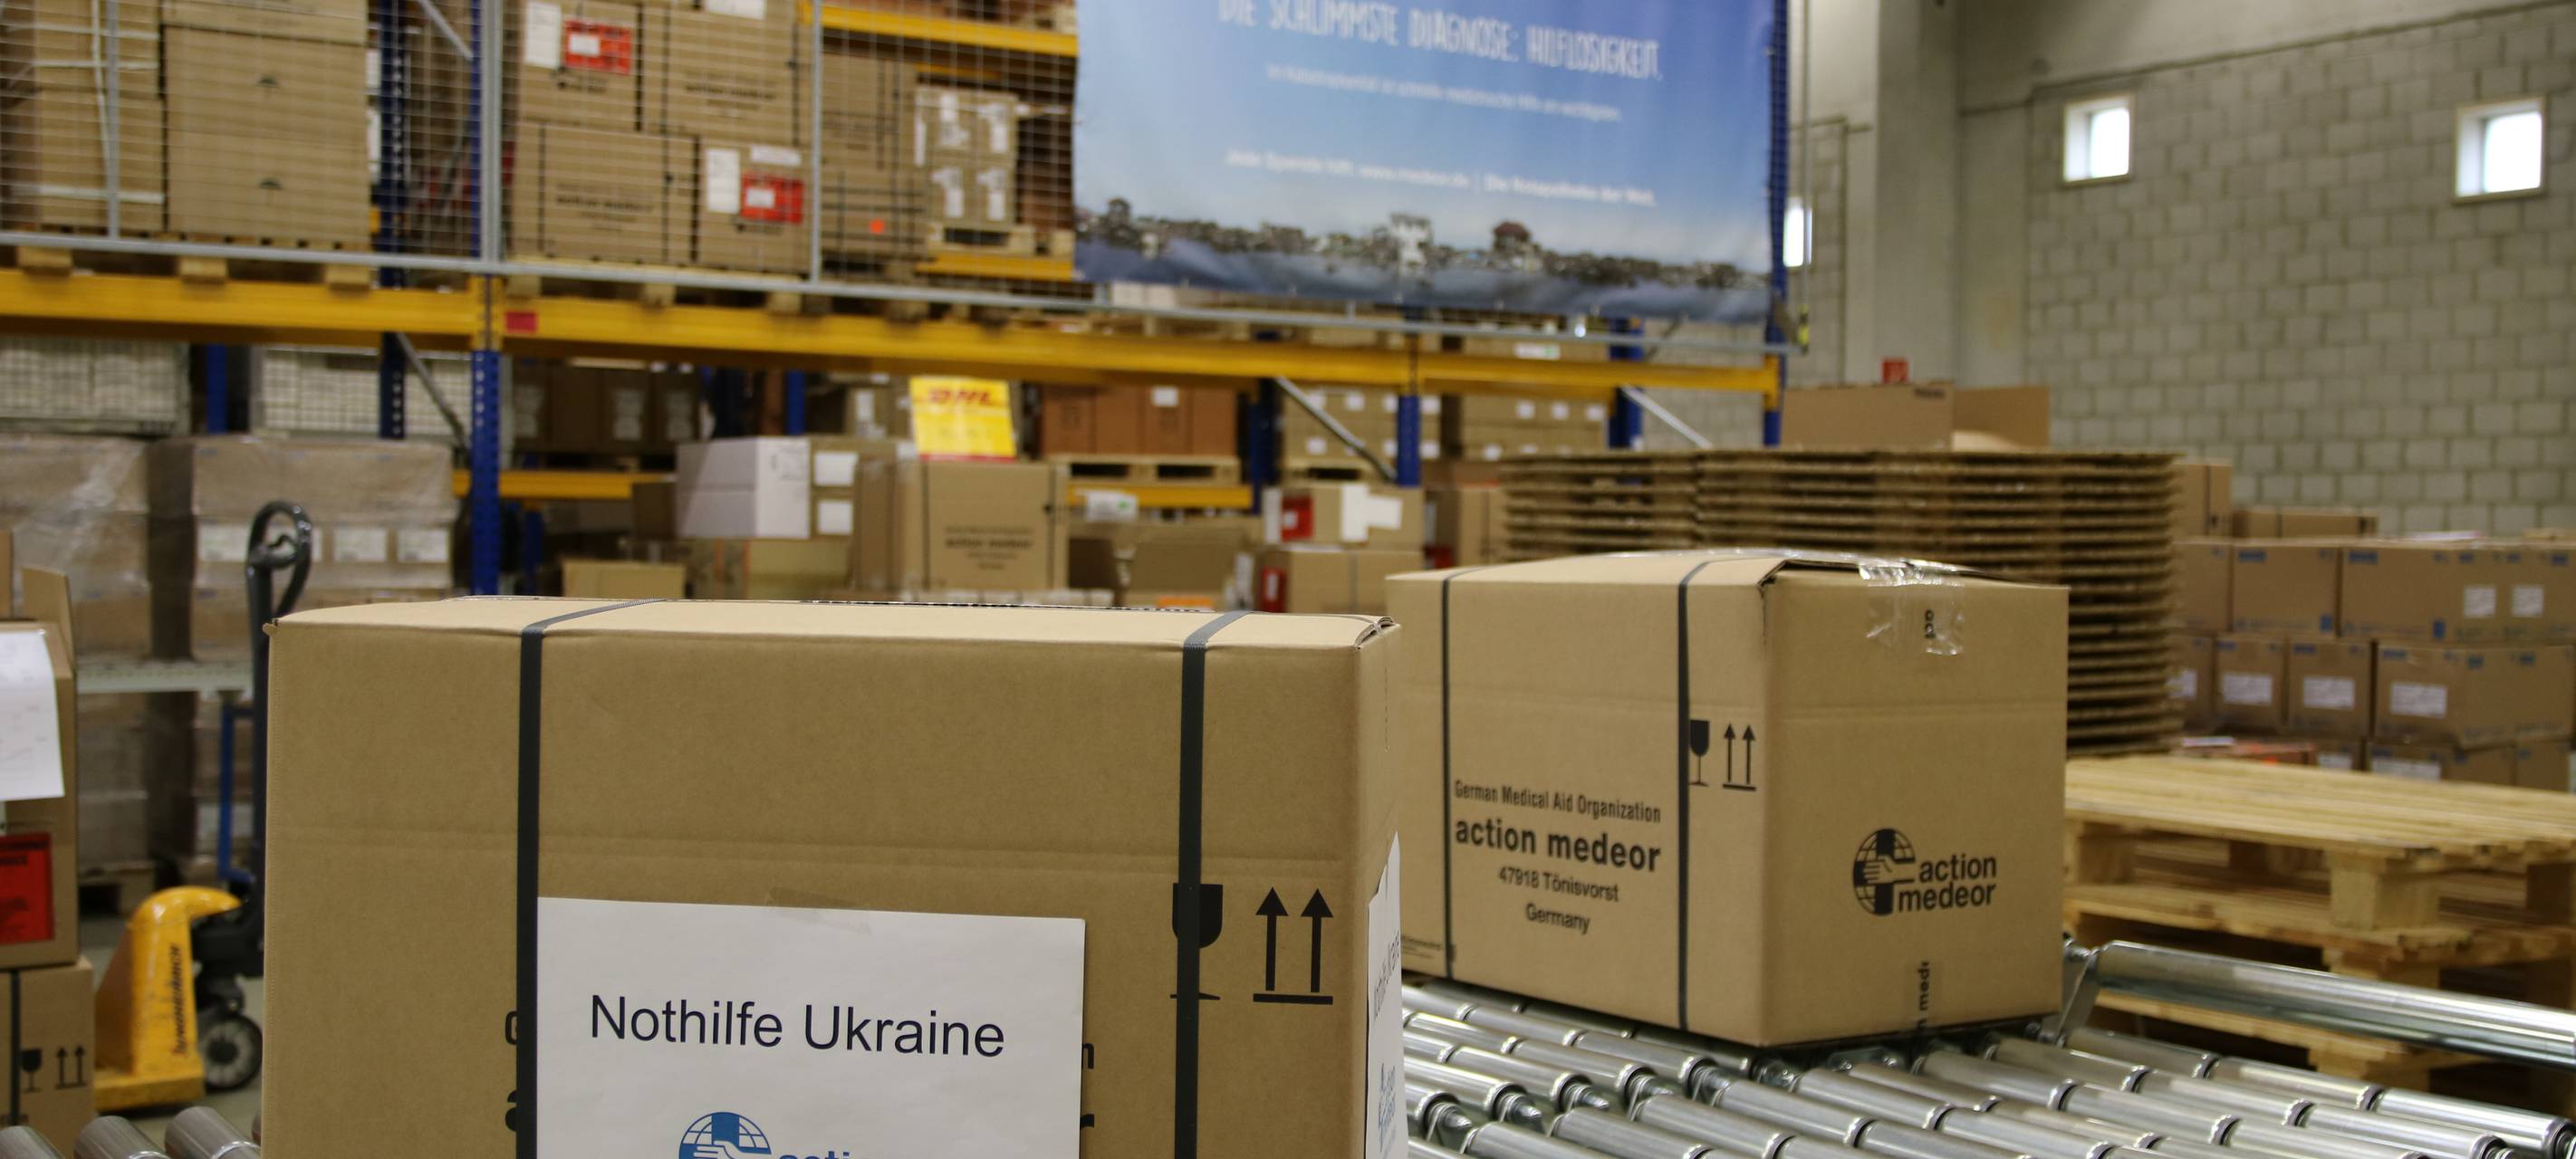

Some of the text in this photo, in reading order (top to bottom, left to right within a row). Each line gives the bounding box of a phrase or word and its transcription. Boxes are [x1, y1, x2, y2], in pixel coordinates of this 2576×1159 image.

[1408, 8, 1519, 63] DIAGNOSE:
[1454, 779, 1661, 823] German Medical Aid Organization
[1455, 818, 1661, 872] action medeor
[1498, 865, 1620, 903] 47918 Tönisvorst
[1919, 853, 1997, 883] action
[1898, 881, 1997, 913] medeor
[1524, 902, 1591, 936] Germany
[591, 994, 1004, 1058] Nothilfe Ukraine
